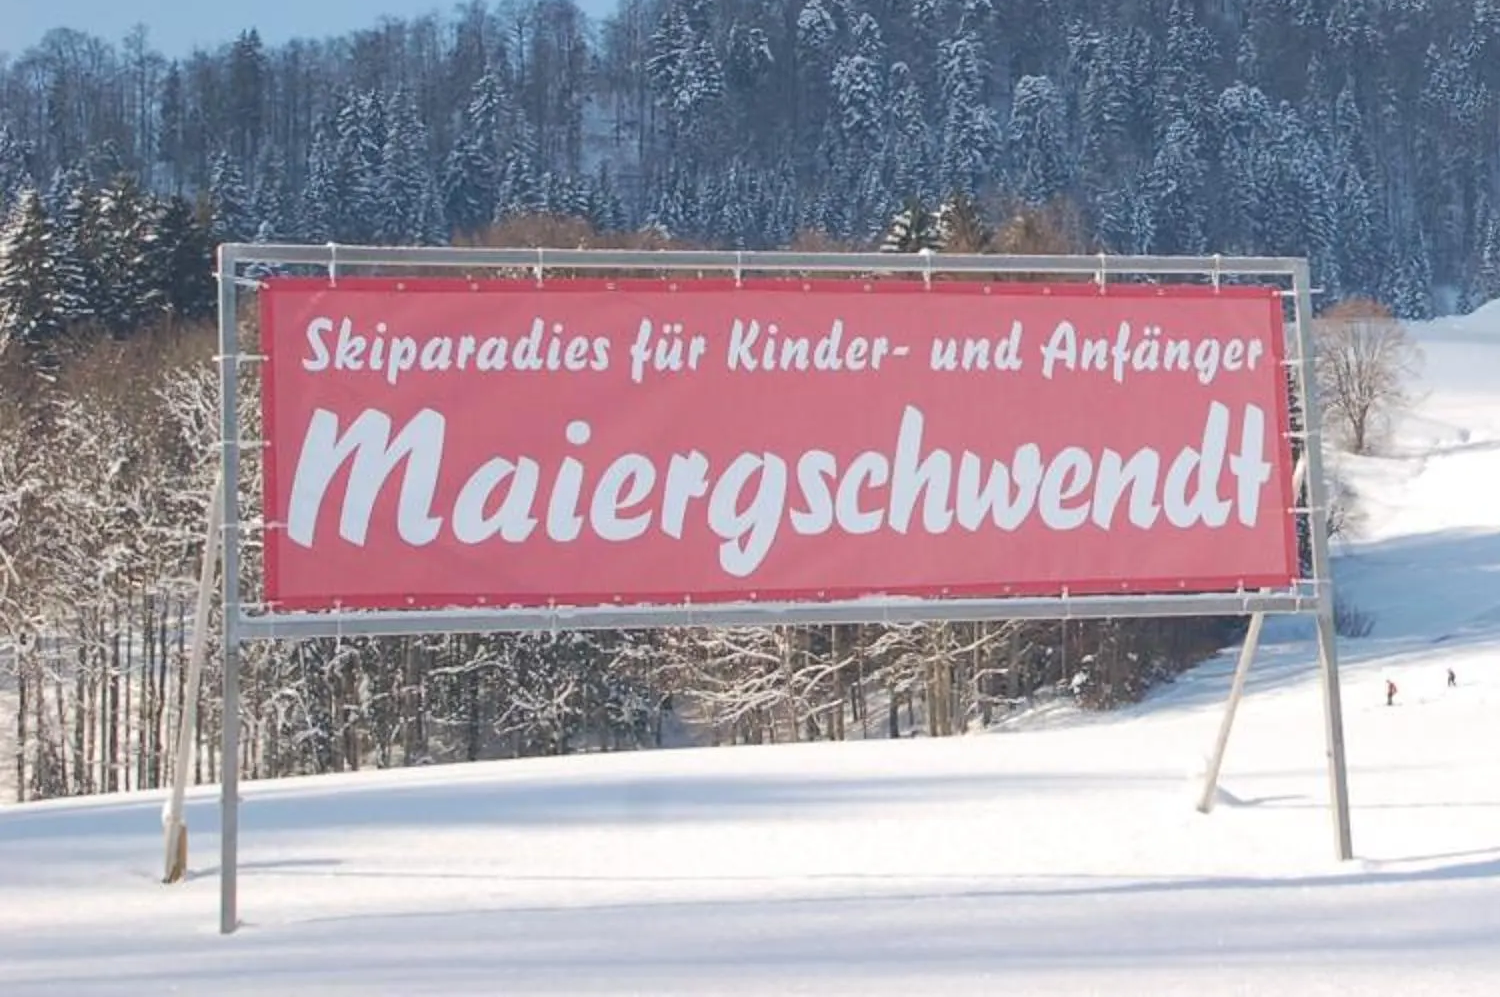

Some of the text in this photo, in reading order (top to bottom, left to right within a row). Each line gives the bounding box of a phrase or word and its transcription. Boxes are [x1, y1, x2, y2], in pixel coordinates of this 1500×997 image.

[302, 317, 1263, 385] Skiparadies für Kinder- und Anfänger
[287, 400, 1273, 578] Maiergschwendt
